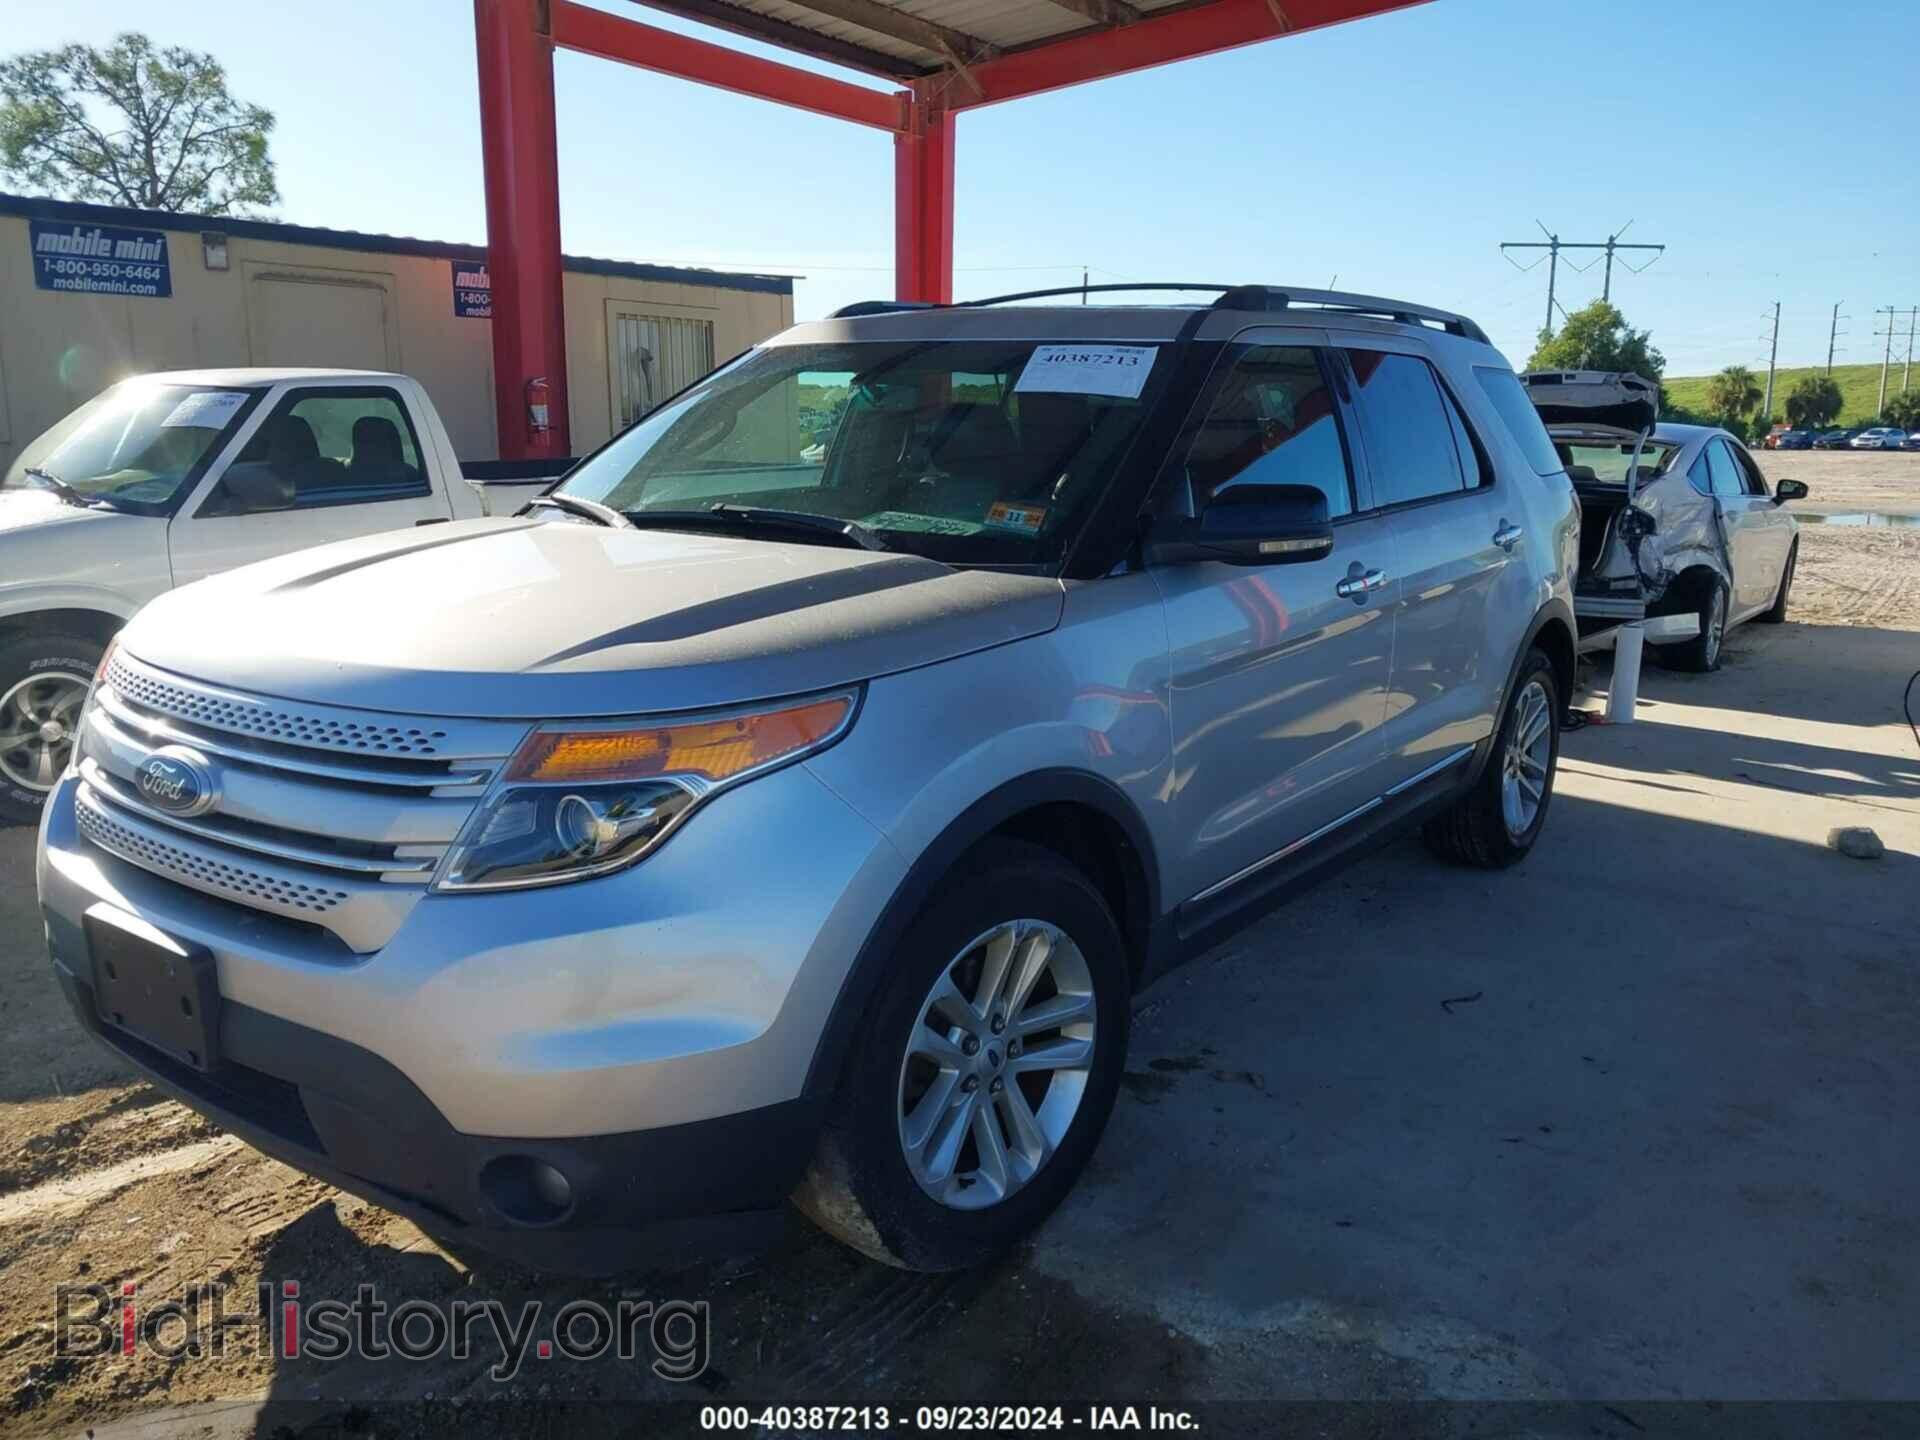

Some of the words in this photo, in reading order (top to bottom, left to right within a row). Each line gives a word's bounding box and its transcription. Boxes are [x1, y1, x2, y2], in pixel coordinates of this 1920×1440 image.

[36, 226, 112, 257] mobile
[115, 237, 162, 260] mini
[43, 259, 160, 280] 1-800-950-6464
[53, 278, 156, 295] mobilemini.com
[1042, 354, 1139, 366] 40387213
[143, 761, 184, 801] Ford
